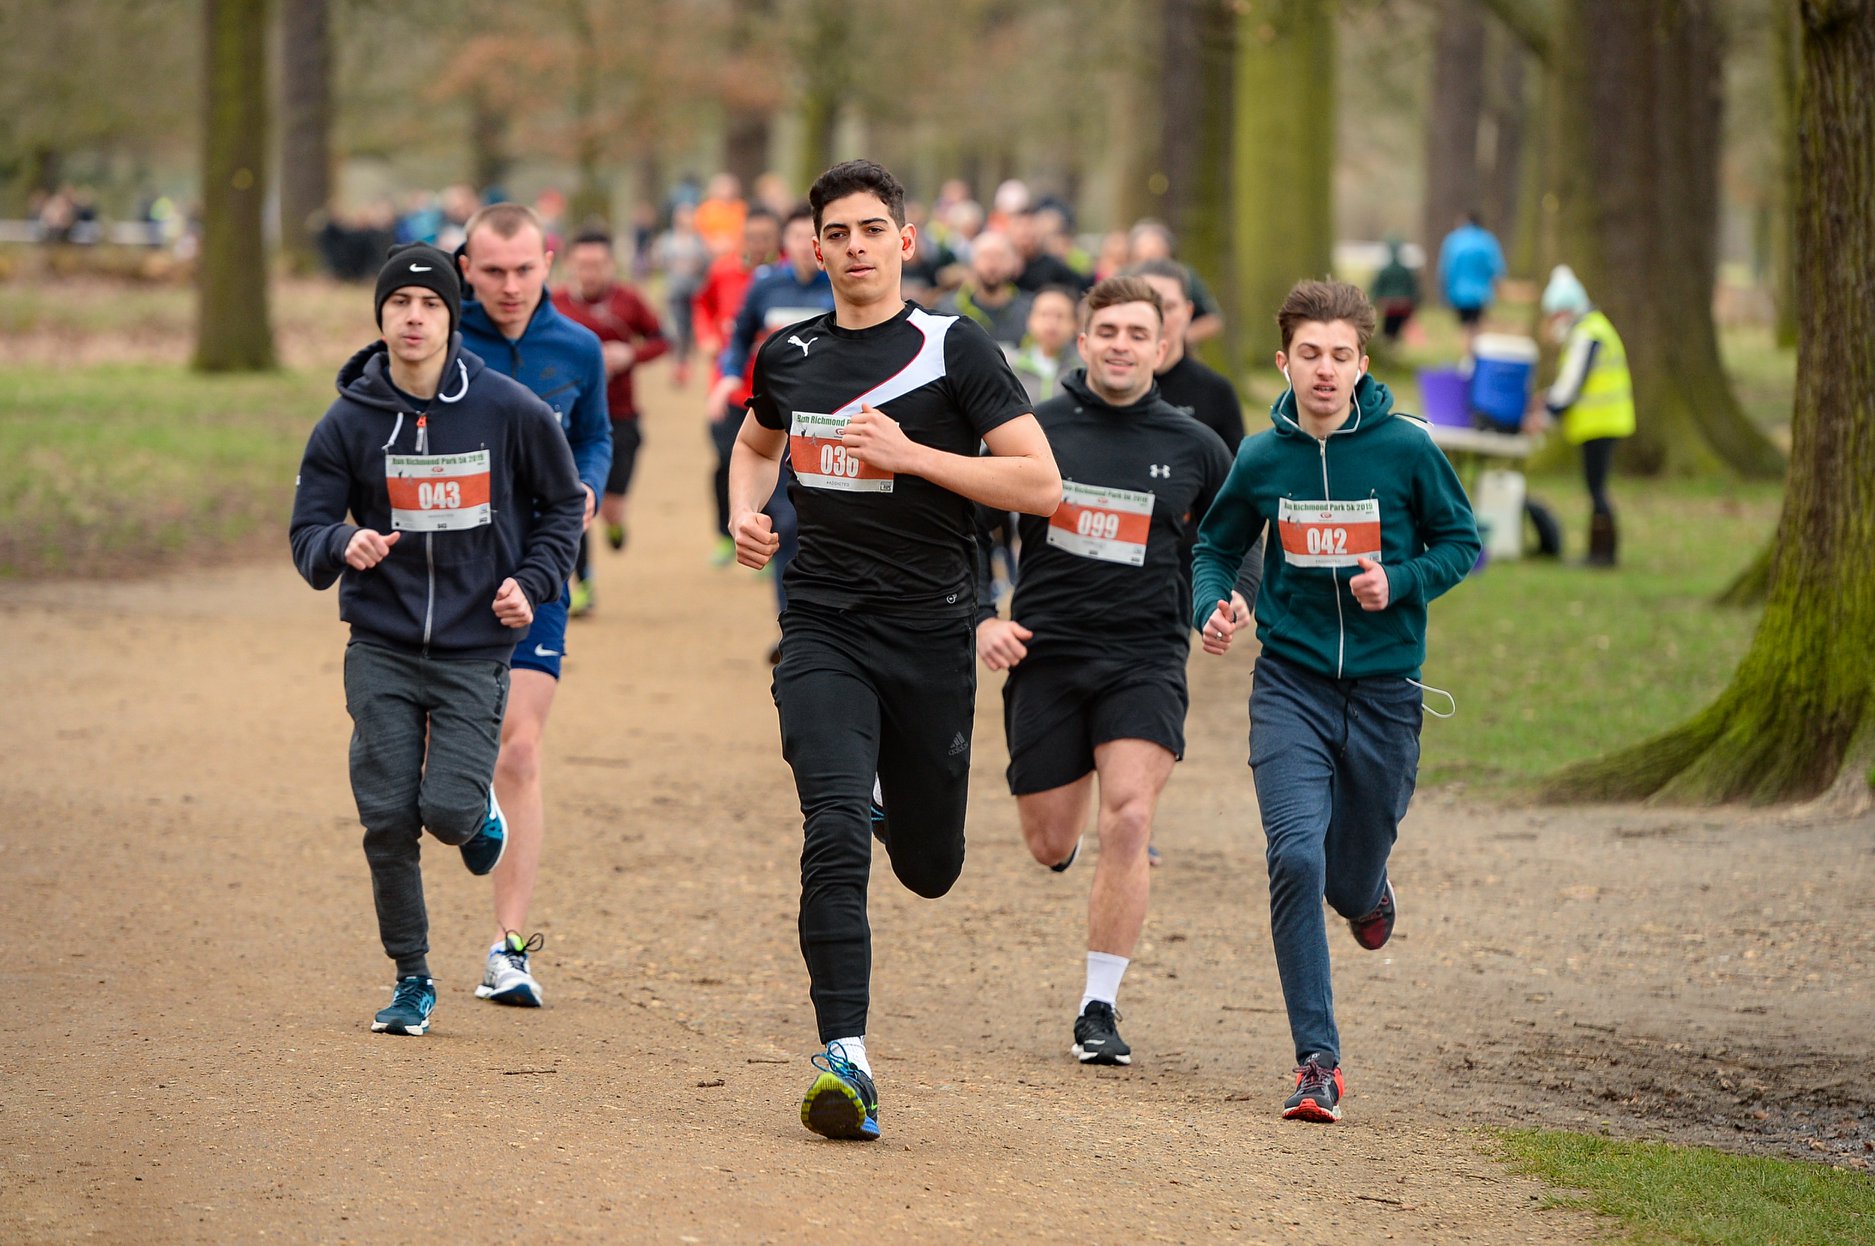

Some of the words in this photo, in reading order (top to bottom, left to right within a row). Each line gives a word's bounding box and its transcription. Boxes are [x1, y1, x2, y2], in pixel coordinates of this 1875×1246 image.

[811, 416, 846, 427] Richmond
[407, 457, 440, 465] Richmond
[418, 481, 460, 509] 043
[1293, 503, 1328, 511] Richmond
[1330, 503, 1345, 511] Park
[1346, 503, 1355, 511] 5k
[1357, 502, 1373, 510] 2019
[1077, 510, 1119, 539] 099
[1307, 527, 1348, 555] 042
